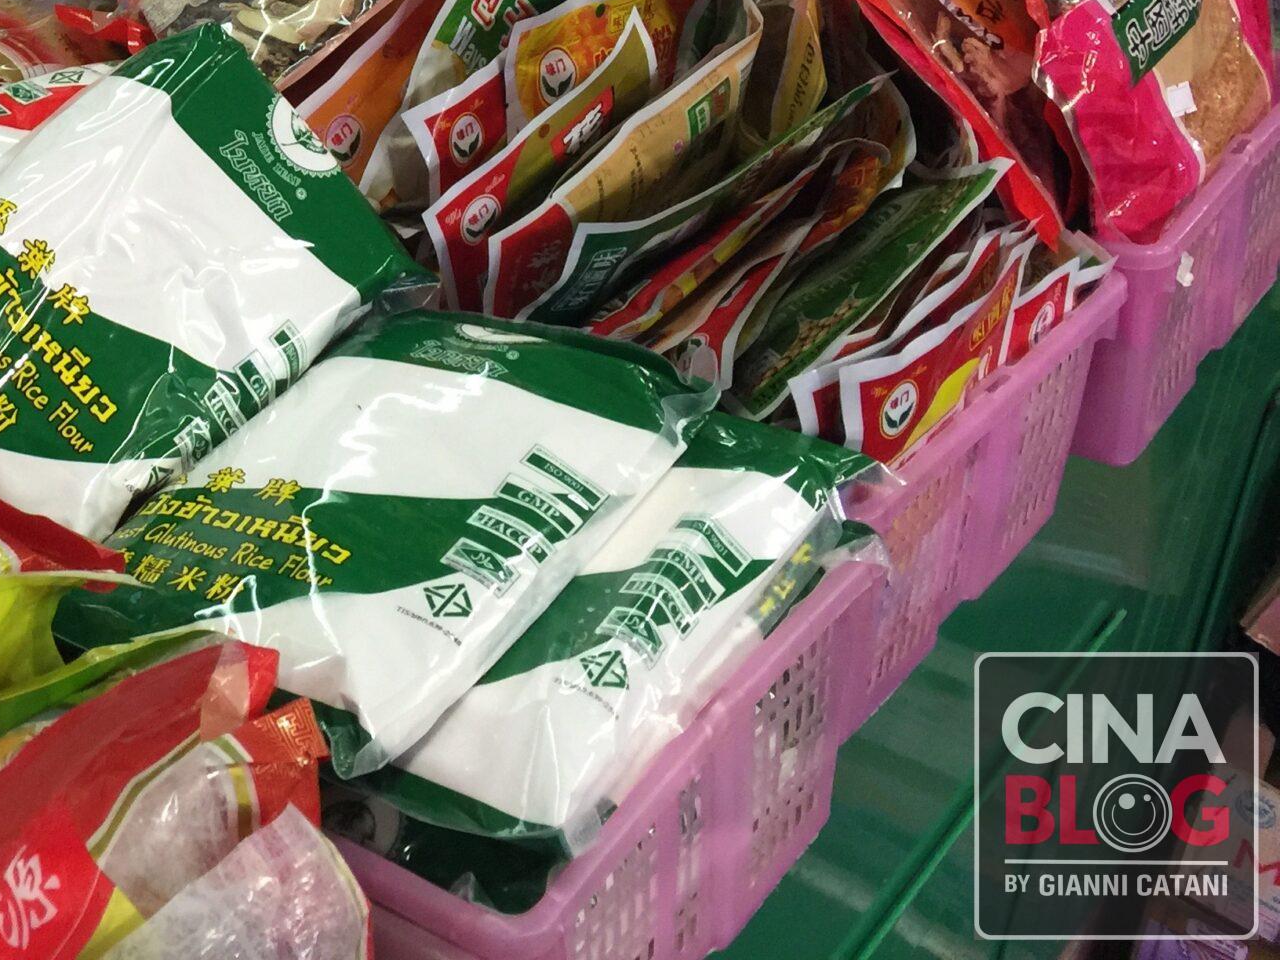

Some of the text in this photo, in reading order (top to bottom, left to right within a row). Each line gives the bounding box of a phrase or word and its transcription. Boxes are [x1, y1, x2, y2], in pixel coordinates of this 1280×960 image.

[11, 360, 50, 410] Rice
[48, 400, 95, 455] Flour
[543, 462, 564, 480] ISO
[517, 489, 561, 521] GMP
[144, 523, 228, 560] Glutinous
[231, 541, 275, 570] Rice
[278, 553, 334, 588] Flour
[666, 550, 706, 586] GMP
